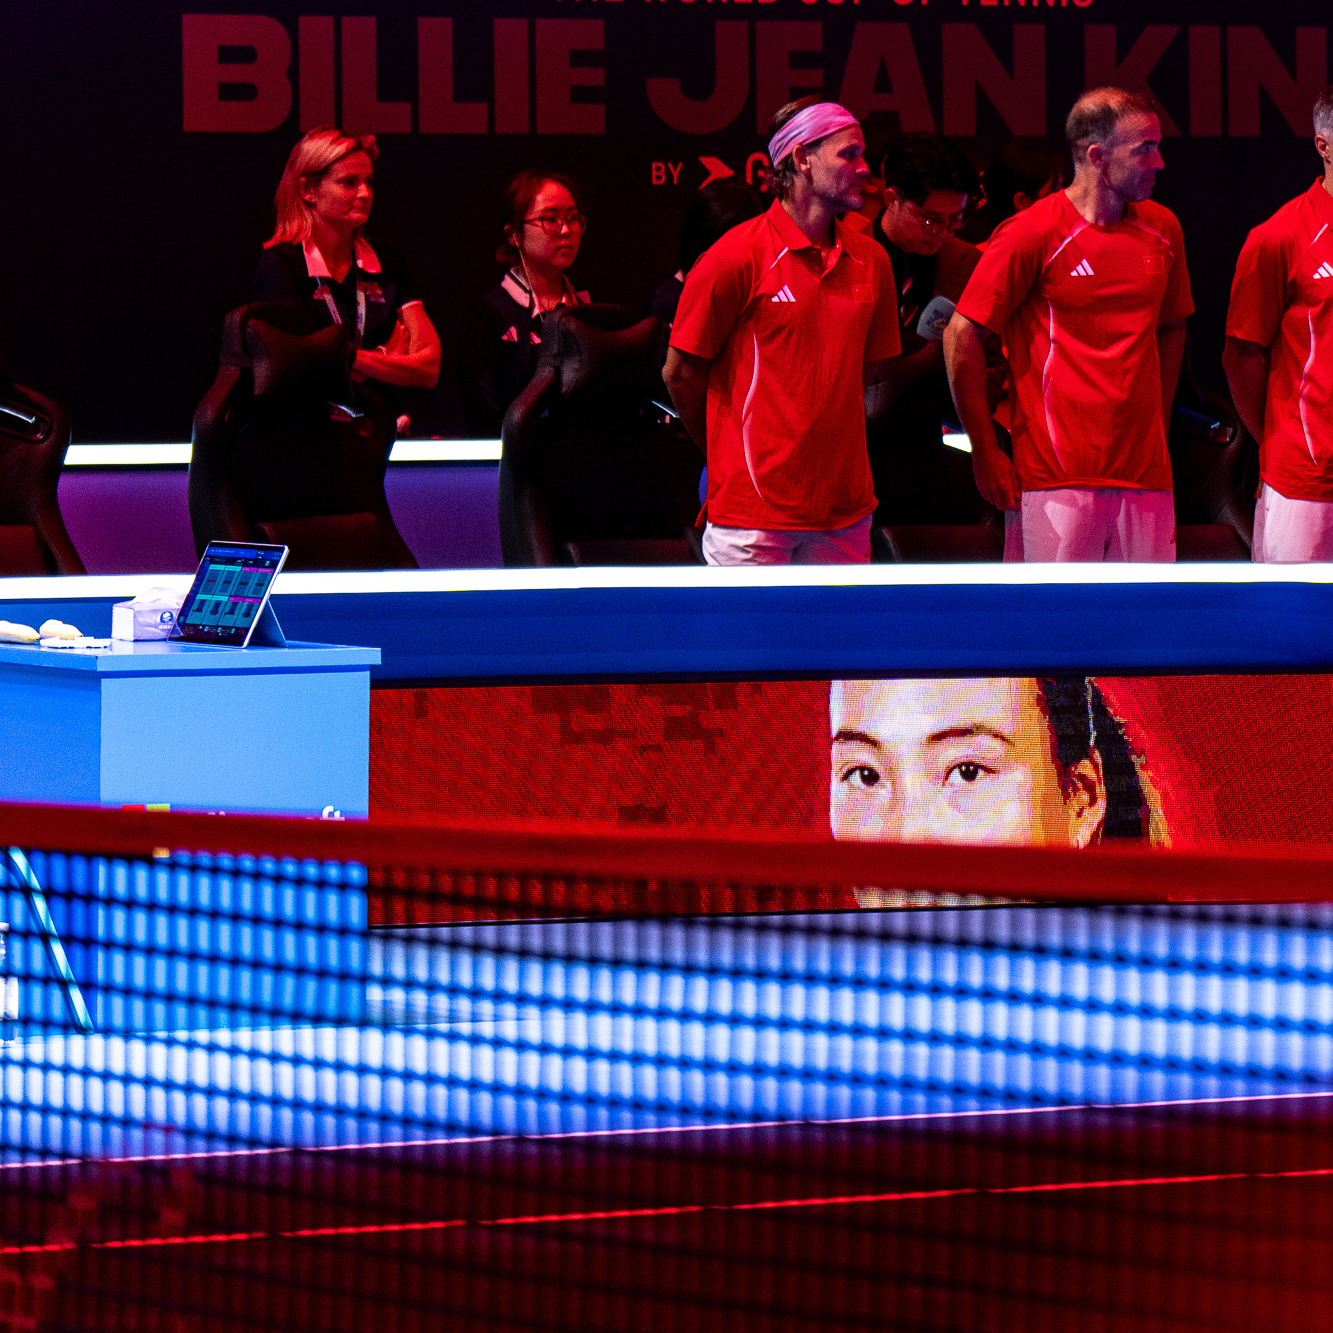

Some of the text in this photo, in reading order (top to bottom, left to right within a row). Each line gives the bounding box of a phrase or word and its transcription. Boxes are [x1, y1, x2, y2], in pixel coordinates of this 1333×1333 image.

[182, 14, 606, 134] BILLIE
[645, 19, 1047, 138] JEAN
[651, 161, 683, 186] BY
